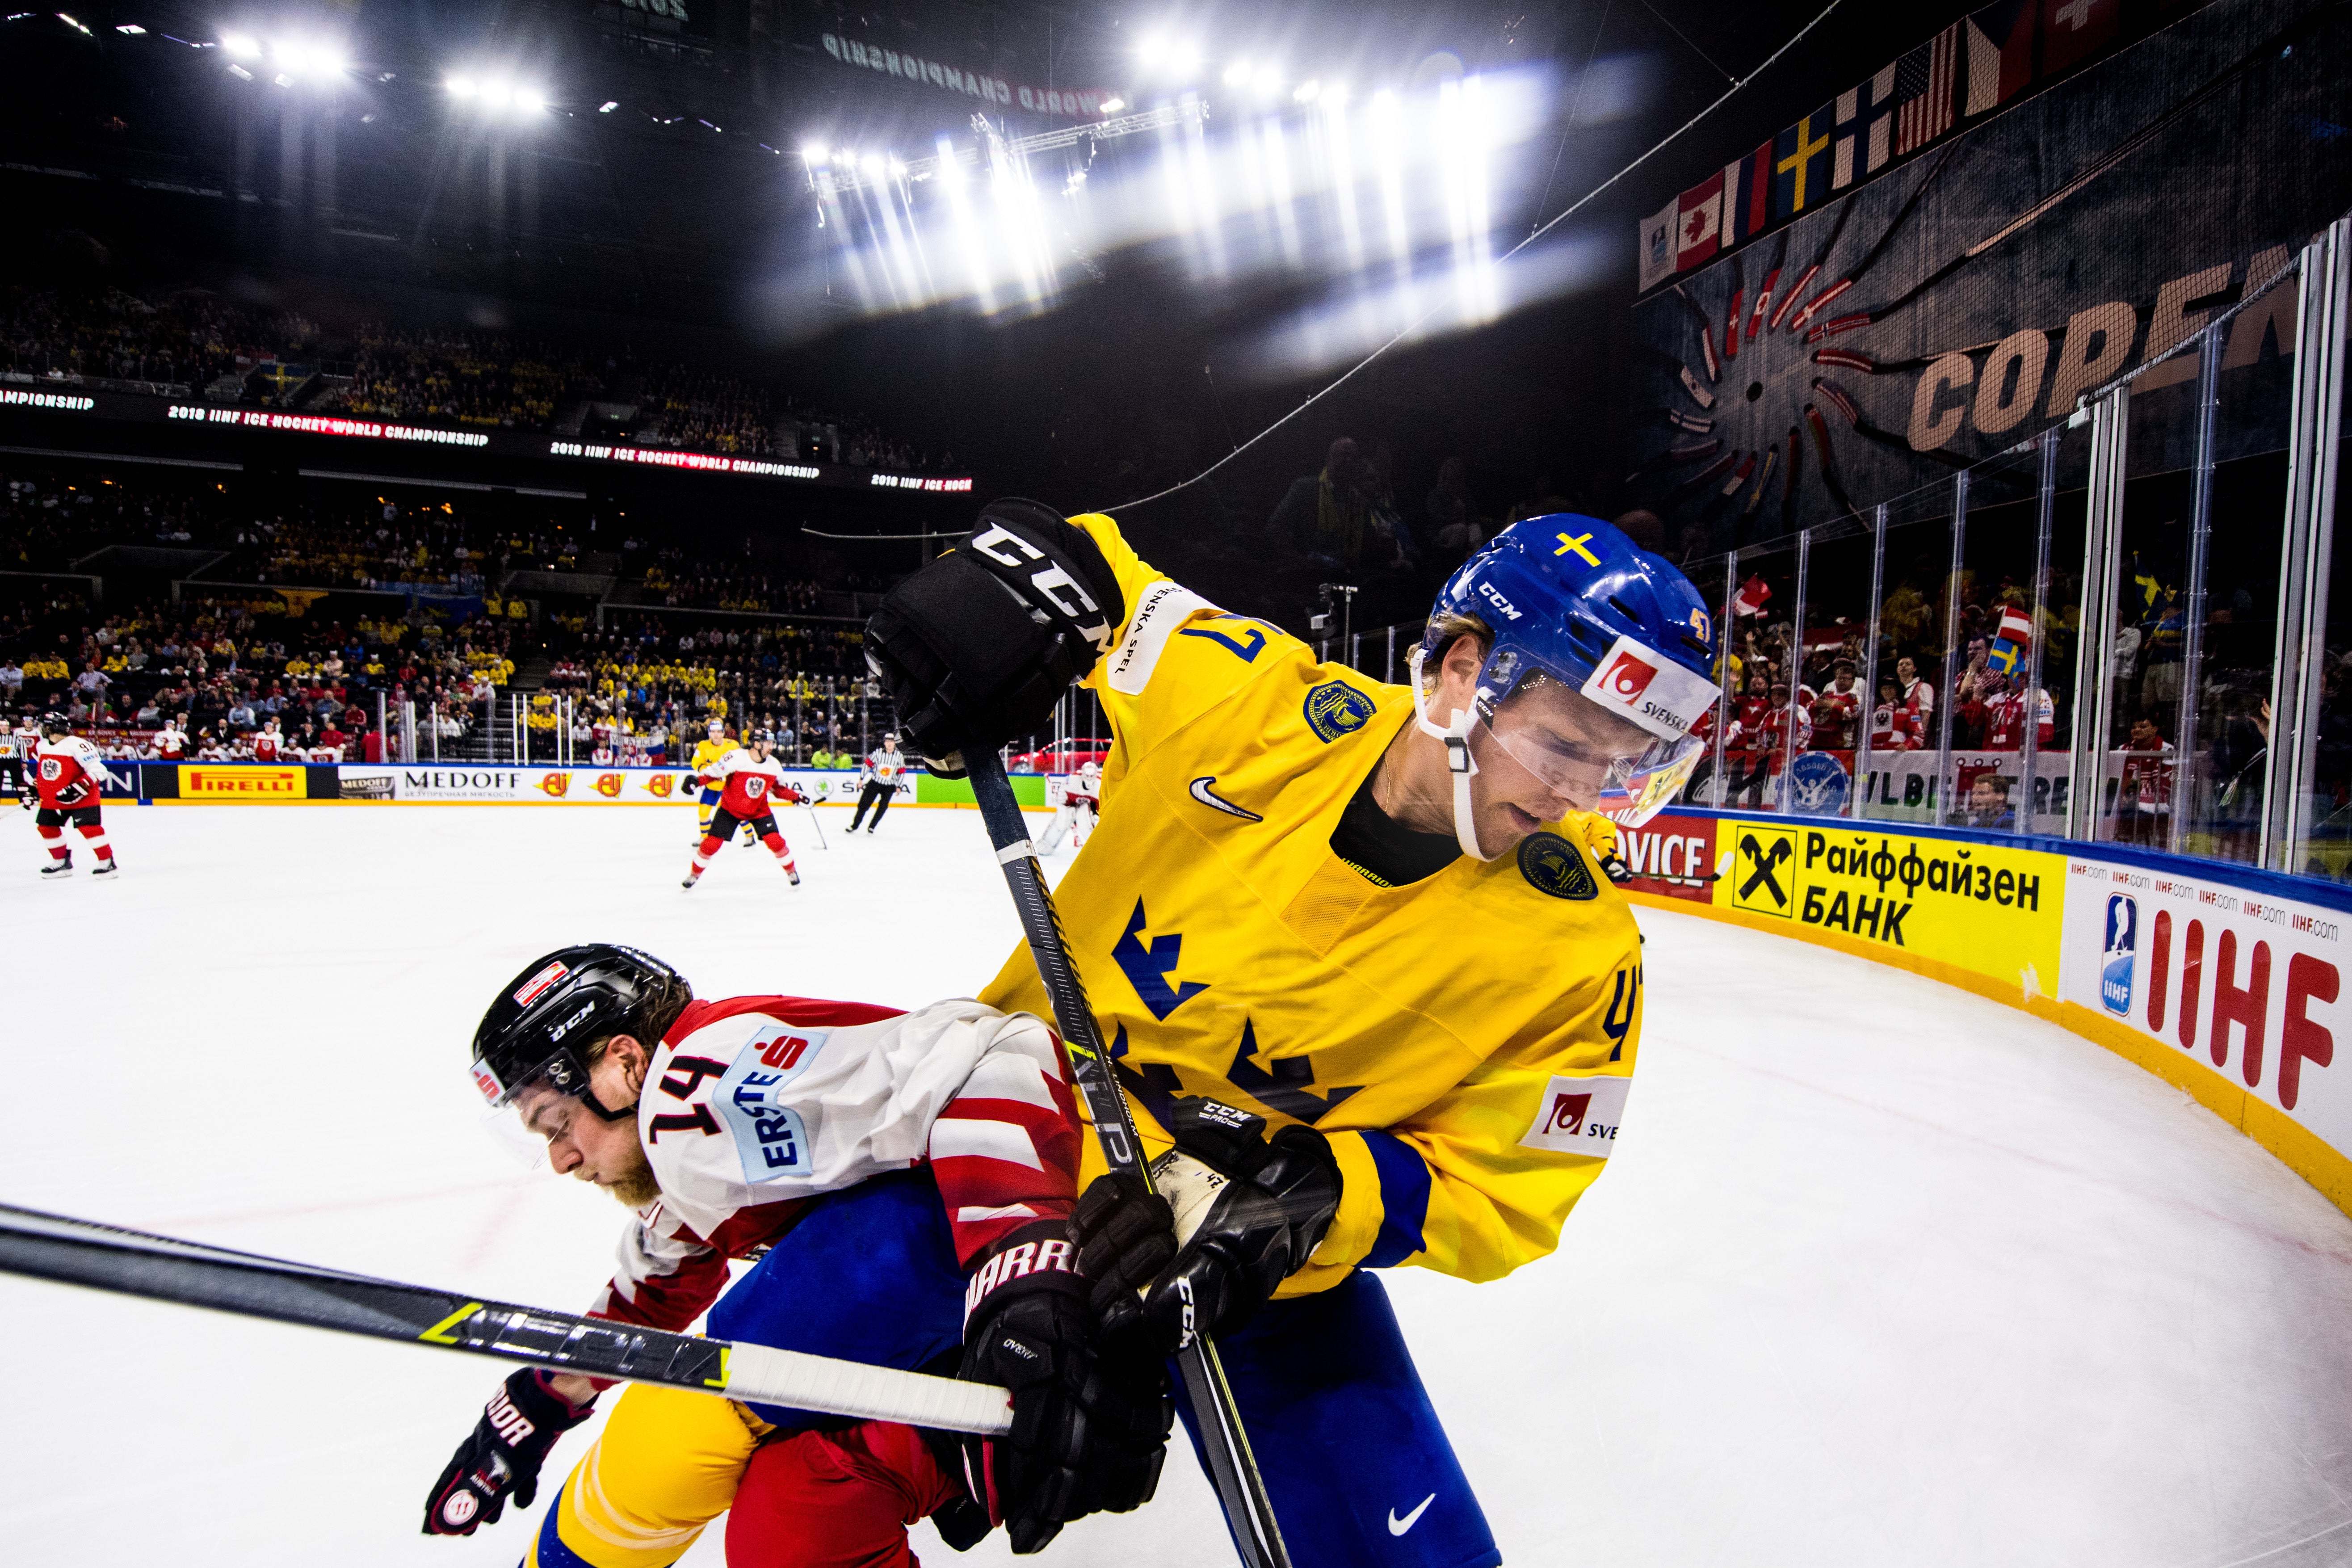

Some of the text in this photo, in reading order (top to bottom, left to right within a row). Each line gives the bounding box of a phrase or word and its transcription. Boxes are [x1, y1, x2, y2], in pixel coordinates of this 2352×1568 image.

[168, 405, 489, 447] 2018 IIHF ICE HOCKEY WORLD CHAMPIONSHIP
[550, 441, 820, 479] 2018 IIHF ICE HOCKEY WORLD CHAMPIONSHIP
[871, 474, 899, 487] 2018
[900, 477, 923, 489] IIHF
[924, 479, 944, 490] ICE
[972, 522, 1113, 664] CCM
[1478, 581, 1523, 621] CCM
[1114, 587, 1183, 674] SVENSKA SPEL
[1476, 700, 1494, 717] CCM
[1642, 701, 1688, 731] SVENSKA
[191, 772, 294, 792] PIRELLI
[405, 770, 521, 789] MEDOFF
[1805, 831, 2040, 912] Райффайзен
[1801, 885, 1913, 947] БАНК
[2071, 863, 2339, 942] IIHF.com IIHF.com IIHF.com IIHF.com IIHF.com IIHF.com
[2104, 979, 2129, 1004] IIHF
[2146, 909, 2340, 1111] IIHF
[548, 1000, 596, 1043] CCM
[649, 1055, 730, 1145] 14
[733, 1071, 798, 1169] ERSTE
[1112, 1073, 1139, 1137] LINDHOLM
[1204, 1101, 1252, 1122] CCM
[1210, 1114, 1228, 1125] PRO
[1588, 1123, 1619, 1141] SVE
[962, 1239, 1085, 1346] WARR
